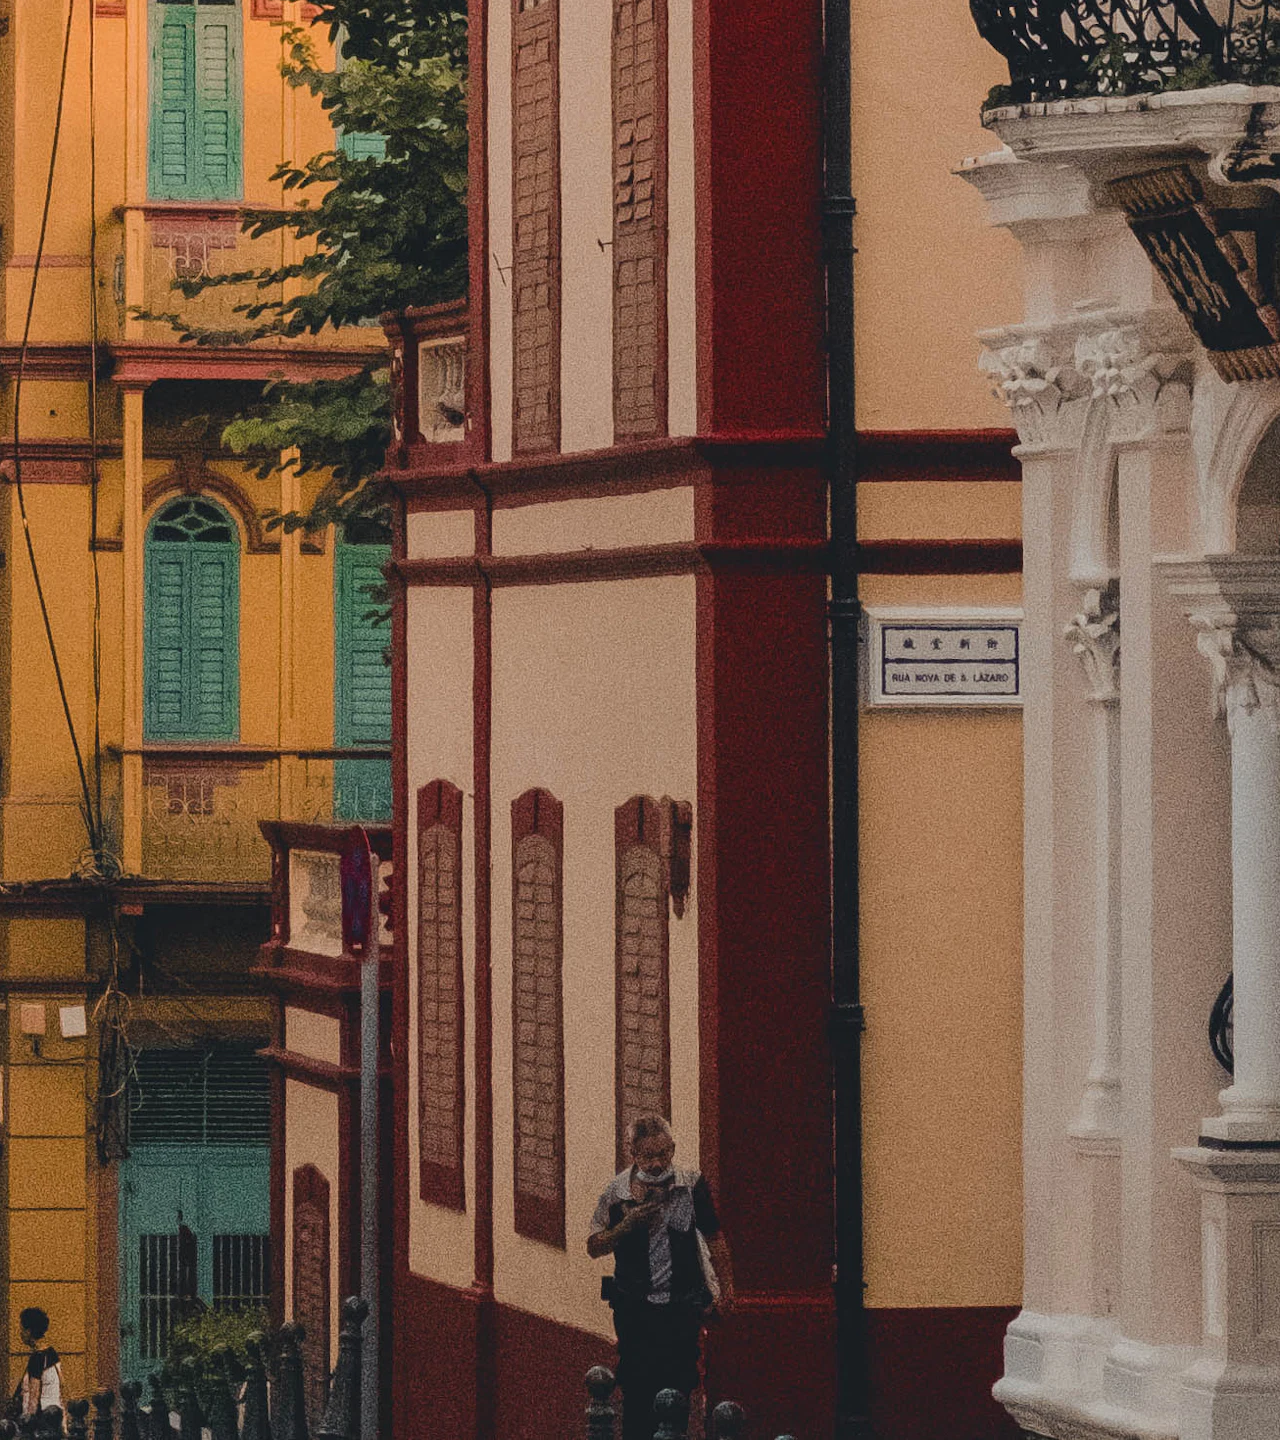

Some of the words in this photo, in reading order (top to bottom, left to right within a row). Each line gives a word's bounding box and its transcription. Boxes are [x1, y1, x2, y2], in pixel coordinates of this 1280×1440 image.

[891, 673, 910, 683] RUA
[915, 673, 940, 683] NOVA
[944, 673, 956, 683] DE
